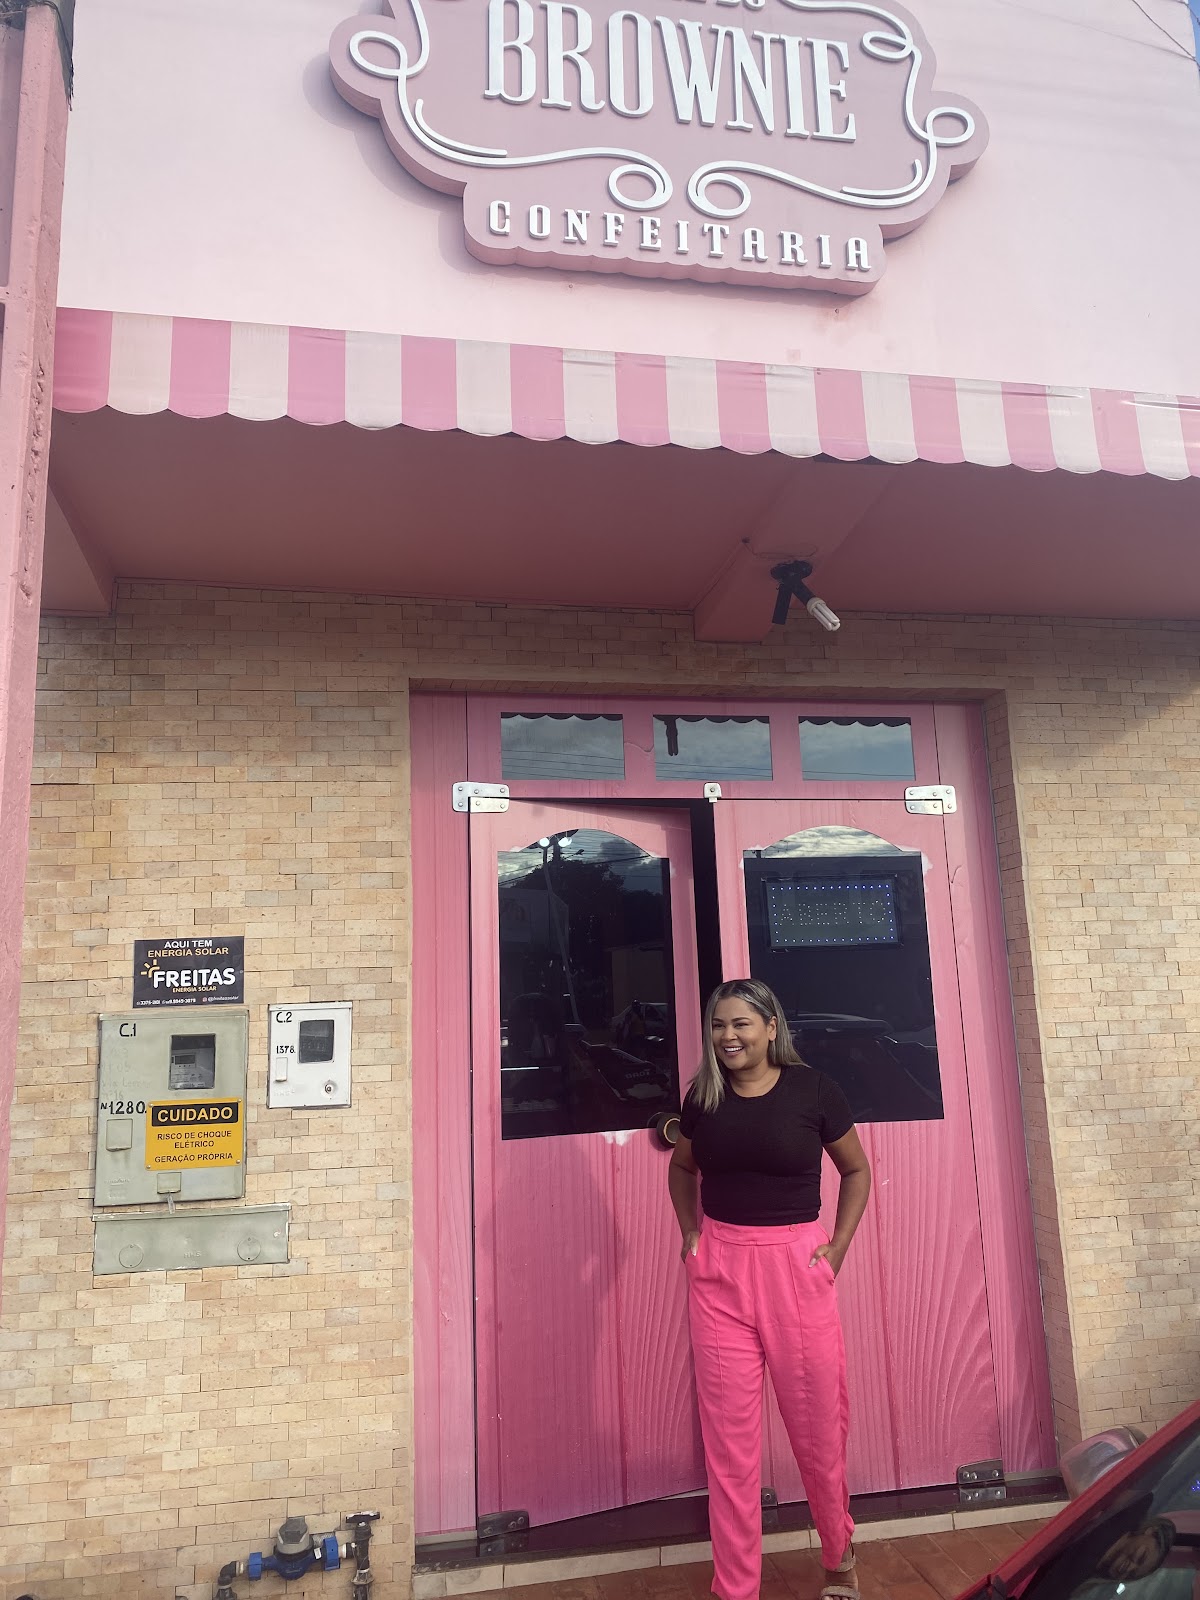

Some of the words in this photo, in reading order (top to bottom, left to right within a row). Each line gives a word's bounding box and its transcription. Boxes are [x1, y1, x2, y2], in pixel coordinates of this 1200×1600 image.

[483, 0, 857, 143] BROWNIE
[488, 200, 872, 271] CONFEITARIA
[779, 901, 886, 926] ABERTO
[164, 940, 189, 949] AQUI
[192, 939, 213, 948] TEM
[148, 949, 192, 958] ENERGIA
[195, 947, 229, 956] SOLAR
[153, 968, 236, 988] FREITAS
[276, 1011, 293, 1023] C.2
[119, 1022, 137, 1037] C.1
[157, 1106, 233, 1122] CUIDADO
[157, 1132, 182, 1140] RISCO
[197, 1130, 232, 1139] CHOQUE
[174, 1140, 214, 1149] ELÉTRICO
[155, 1154, 195, 1163] GERAÇÃO
[197, 1152, 233, 1161] PRÓPRIA
